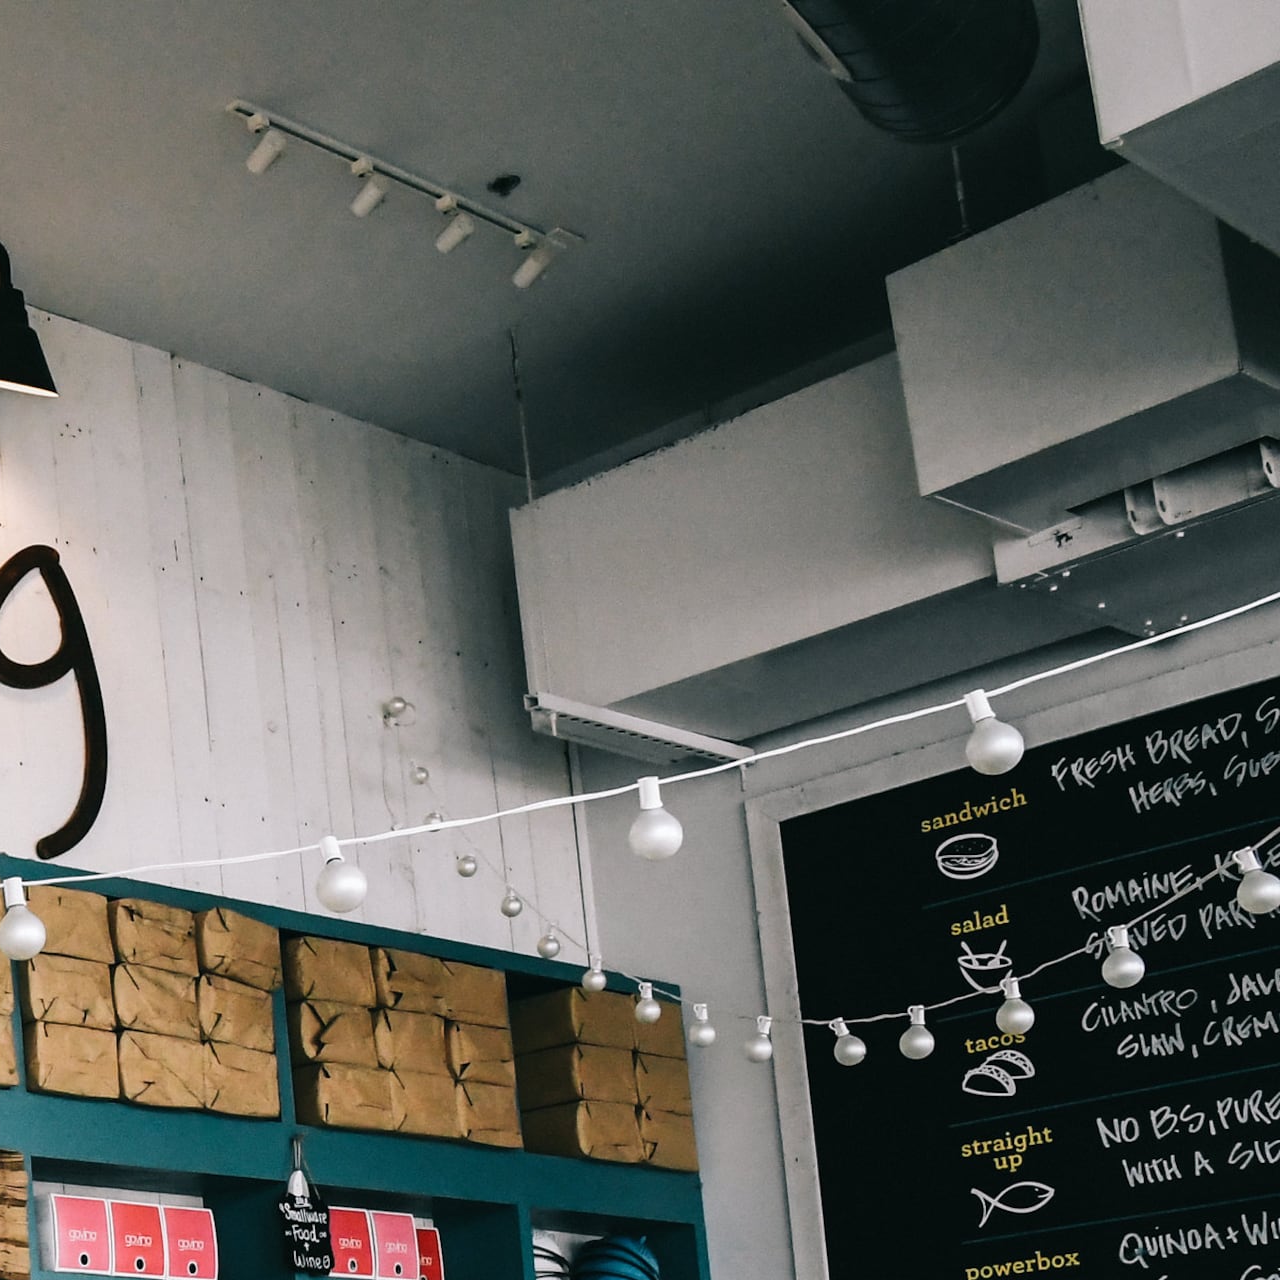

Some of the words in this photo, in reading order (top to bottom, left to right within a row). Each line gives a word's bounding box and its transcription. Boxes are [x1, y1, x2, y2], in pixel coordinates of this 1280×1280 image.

[1051, 743, 1136, 792] FRESH
[1145, 712, 1248, 765] BREAD,
[921, 788, 1028, 833] sandwich
[950, 905, 1010, 937] salad
[965, 1032, 1027, 1055] tacos
[961, 1126, 1054, 1158] straight
[1096, 1117, 1140, 1148] NO
[993, 1152, 1023, 1172] up
[1122, 1155, 1182, 1187] WITH
[1194, 1151, 1215, 1176] A
[292, 1224, 320, 1243] Food
[1119, 1223, 1225, 1269] QUINOA
[293, 1250, 322, 1269] Wine
